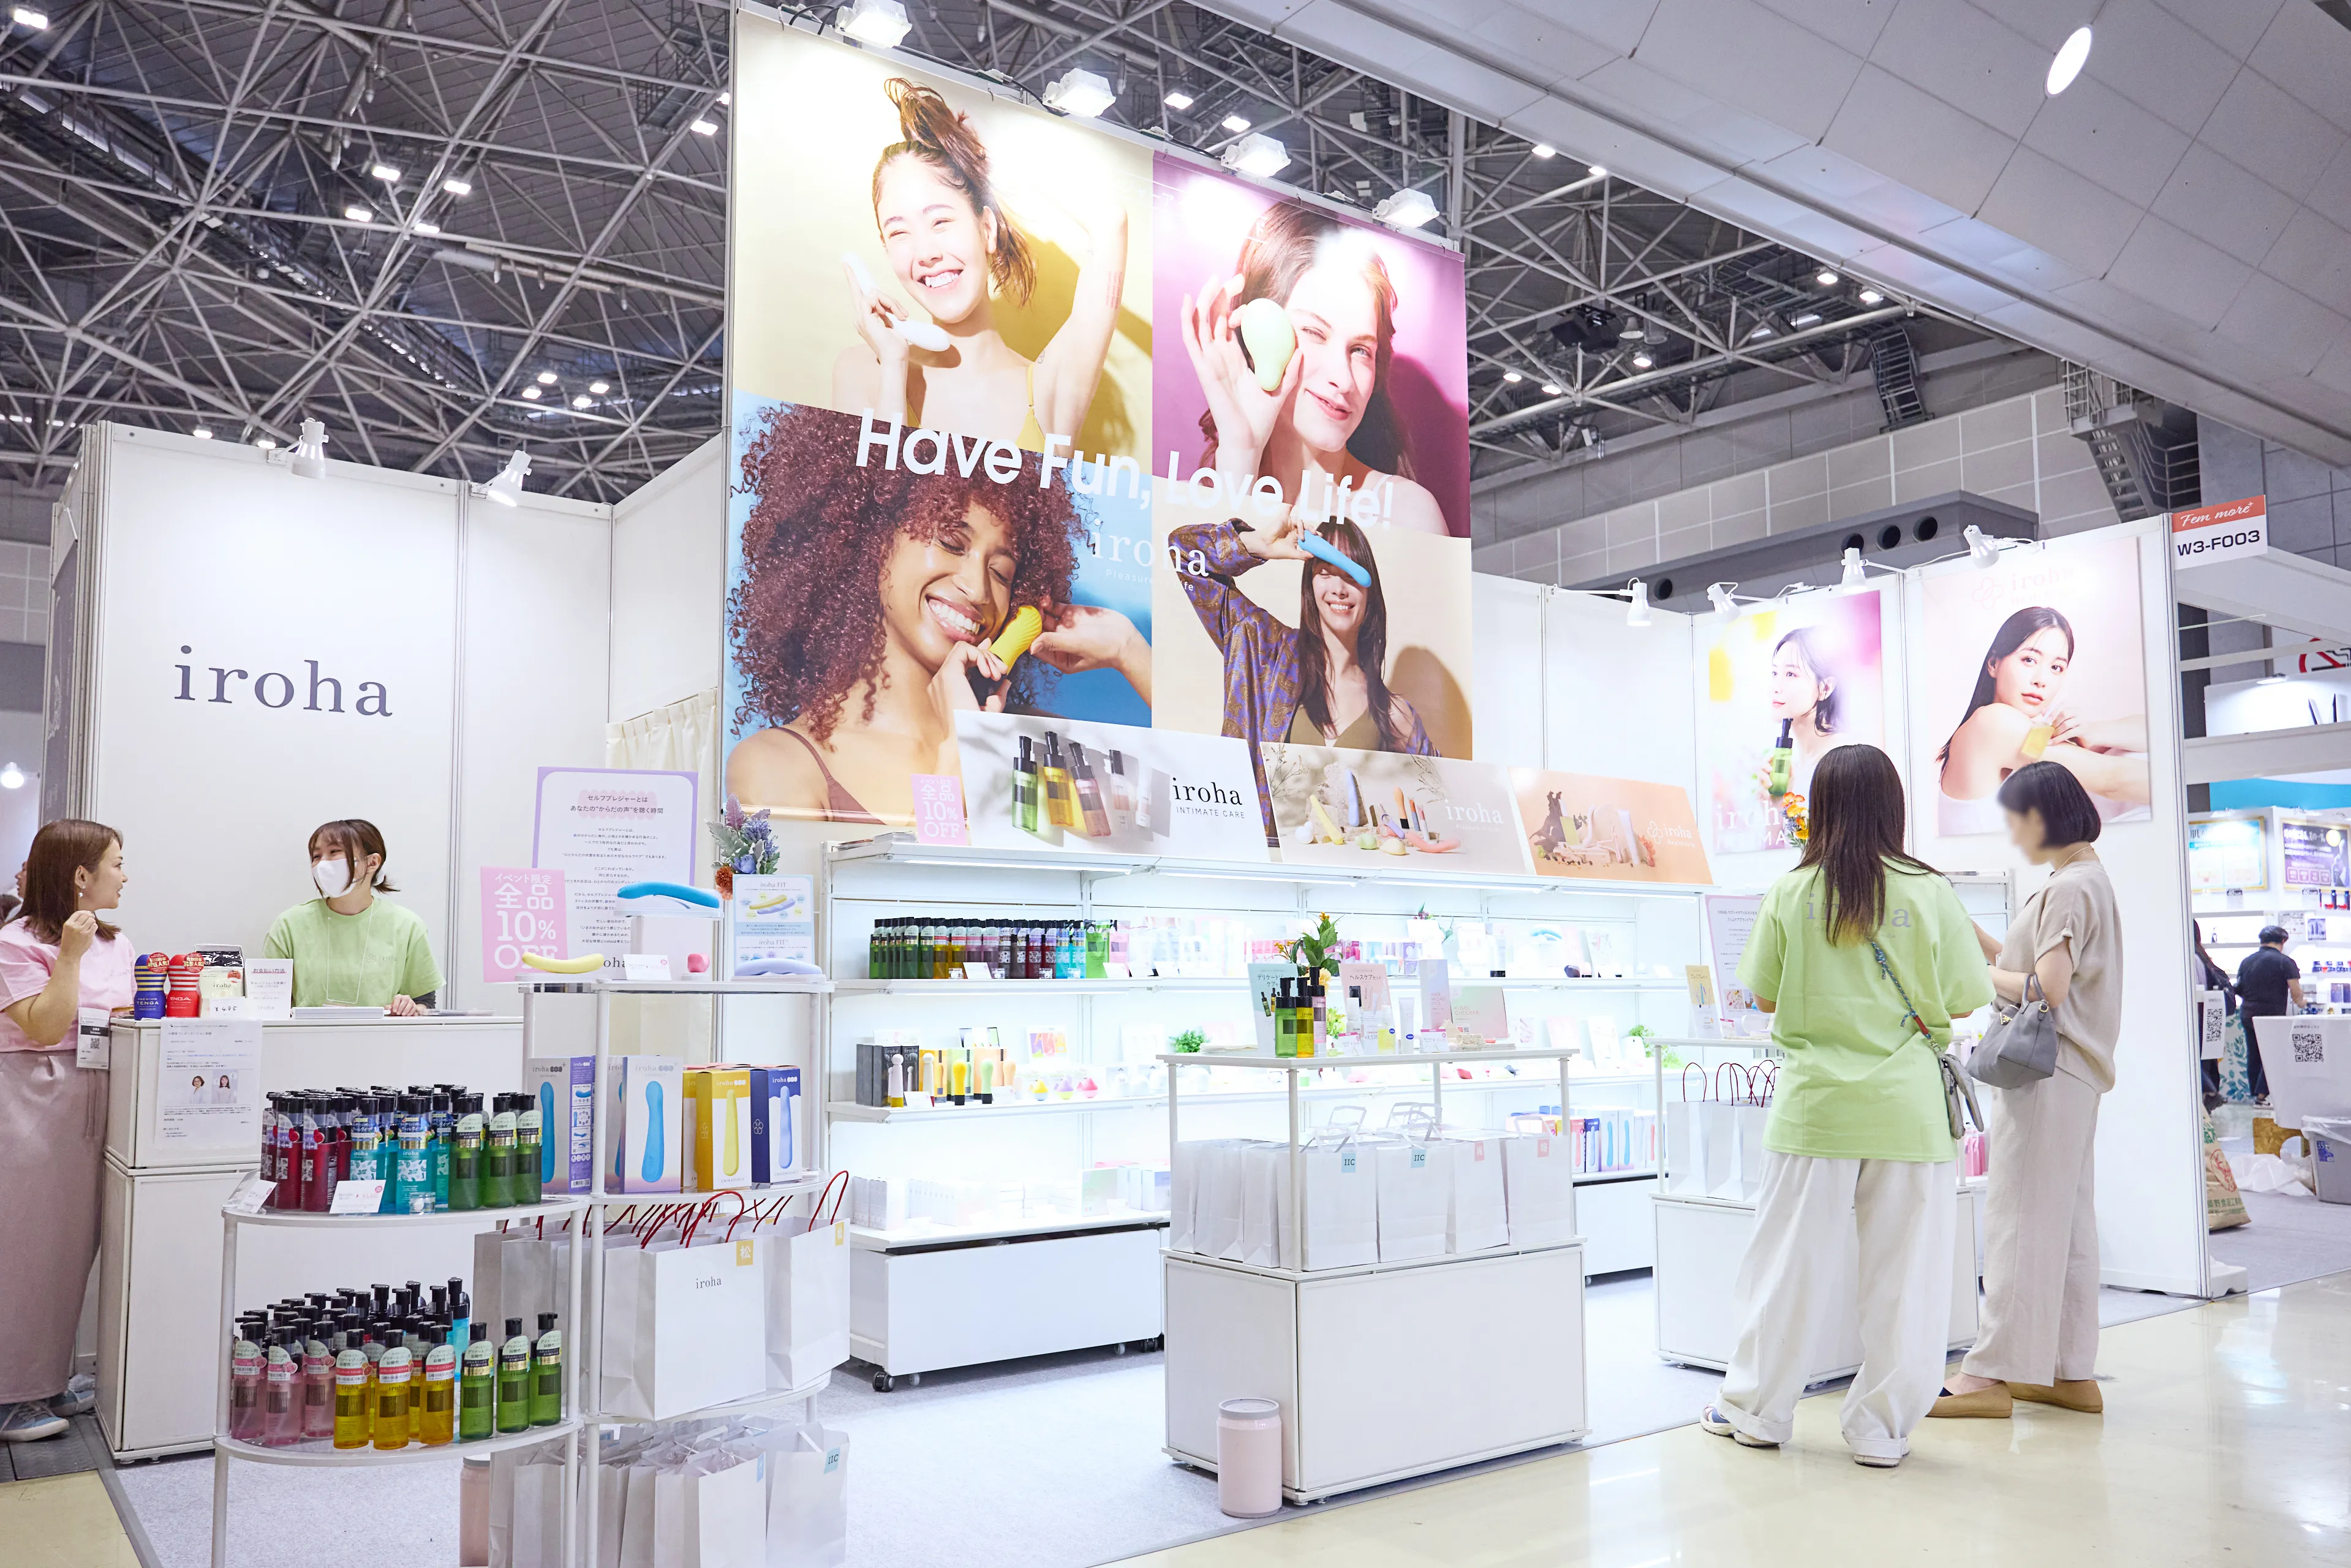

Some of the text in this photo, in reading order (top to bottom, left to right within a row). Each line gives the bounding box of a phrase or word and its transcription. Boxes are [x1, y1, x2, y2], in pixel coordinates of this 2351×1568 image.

[855, 407, 1395, 531] Have Fun, Love Life!
[2180, 512, 2211, 527] Fem
[1090, 518, 1210, 577] iroha
[2177, 530, 2260, 557] W3-F003
[175, 645, 393, 717] iroha
[920, 784, 955, 802] 全品
[1172, 777, 1243, 806] iroha
[923, 801, 958, 821] 10%
[1176, 806, 1245, 819] INTIMATE CARE
[1444, 799, 1504, 824] iroha
[1715, 800, 1784, 830] iroh
[924, 821, 960, 838] OFF
[1664, 823, 1692, 839] iroha
[495, 873, 553, 884] イベント限定
[494, 883, 554, 910] 全品
[497, 910, 556, 942] 10%
[740, 1245, 751, 1259] 松
[696, 1276, 722, 1289] iroha
[828, 1454, 839, 1464] IIC
